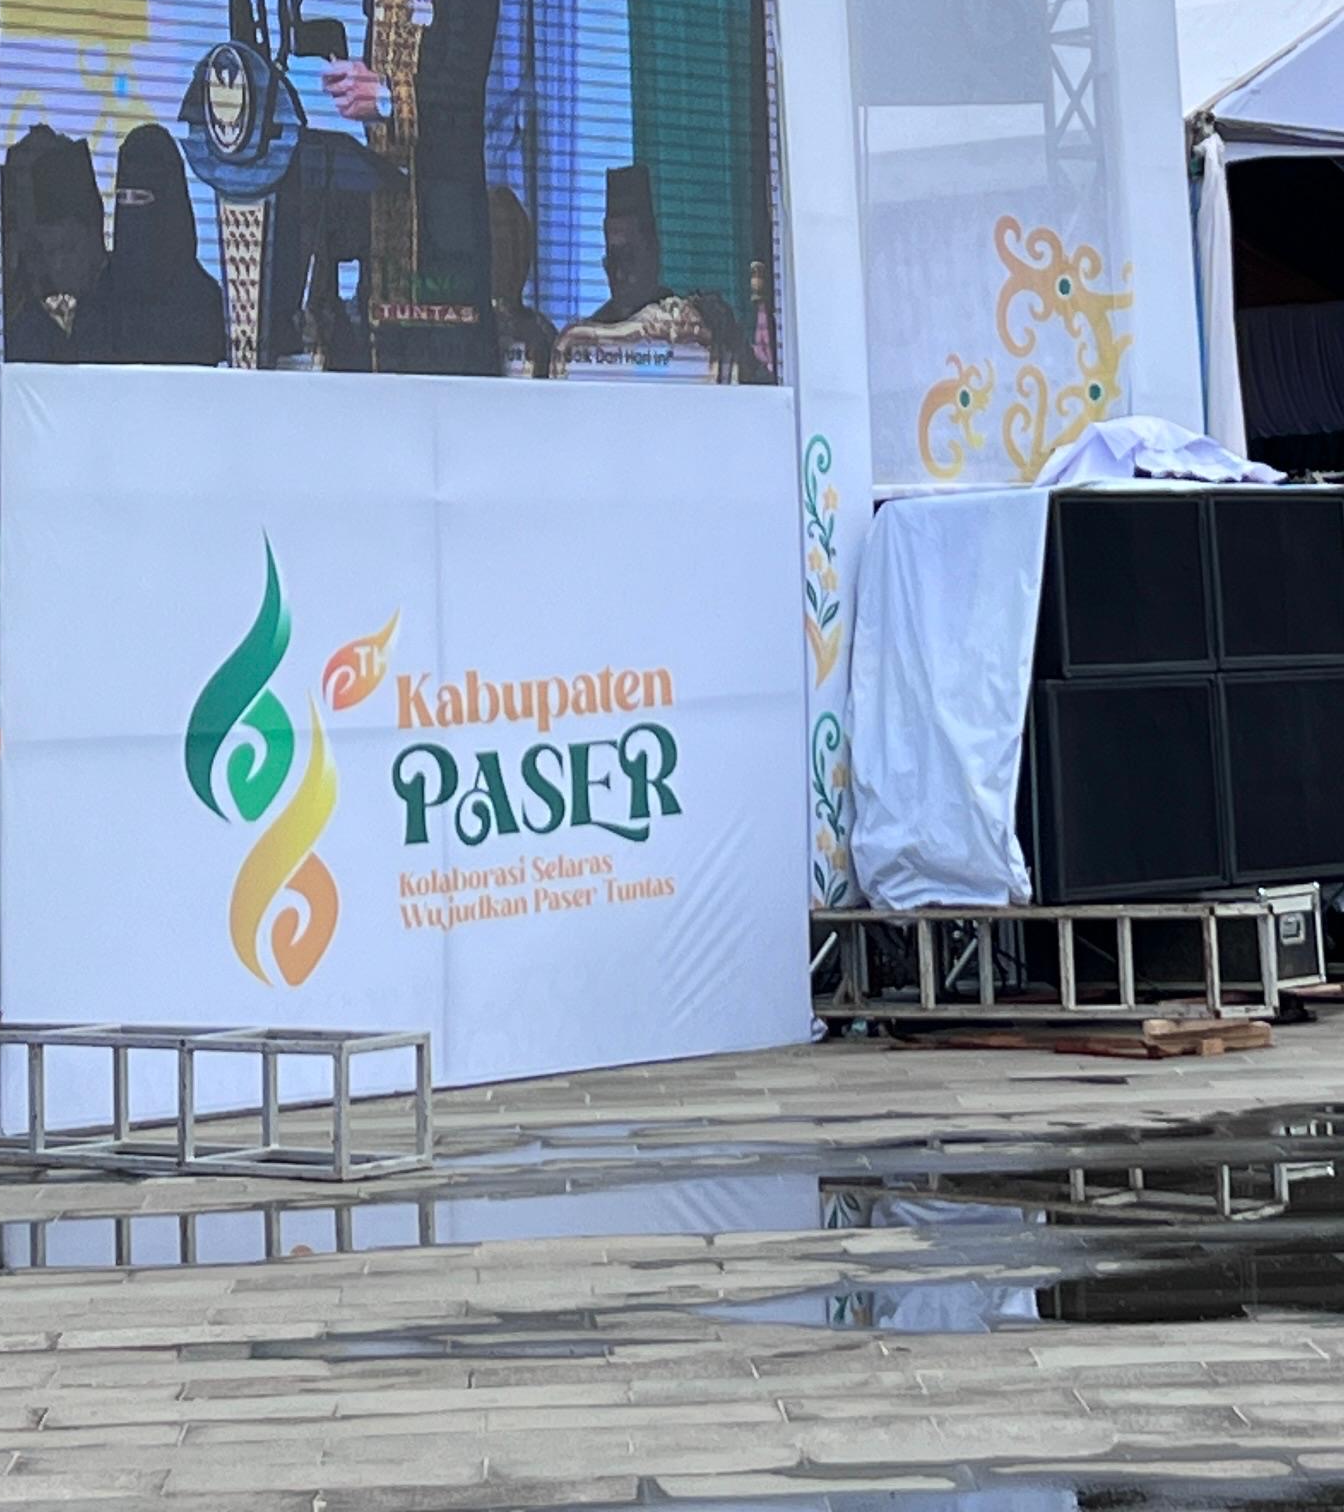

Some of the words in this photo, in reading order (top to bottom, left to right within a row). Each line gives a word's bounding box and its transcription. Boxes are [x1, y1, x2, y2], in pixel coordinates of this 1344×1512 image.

[395, 665, 674, 733] Kabupaten
[392, 721, 683, 847] PASER
[399, 855, 526, 899] Kolaborasi
[531, 853, 614, 882] Selaras
[399, 888, 529, 931] Wujudkan
[533, 886, 594, 913] Paser
[602, 875, 676, 904] Tuntas
